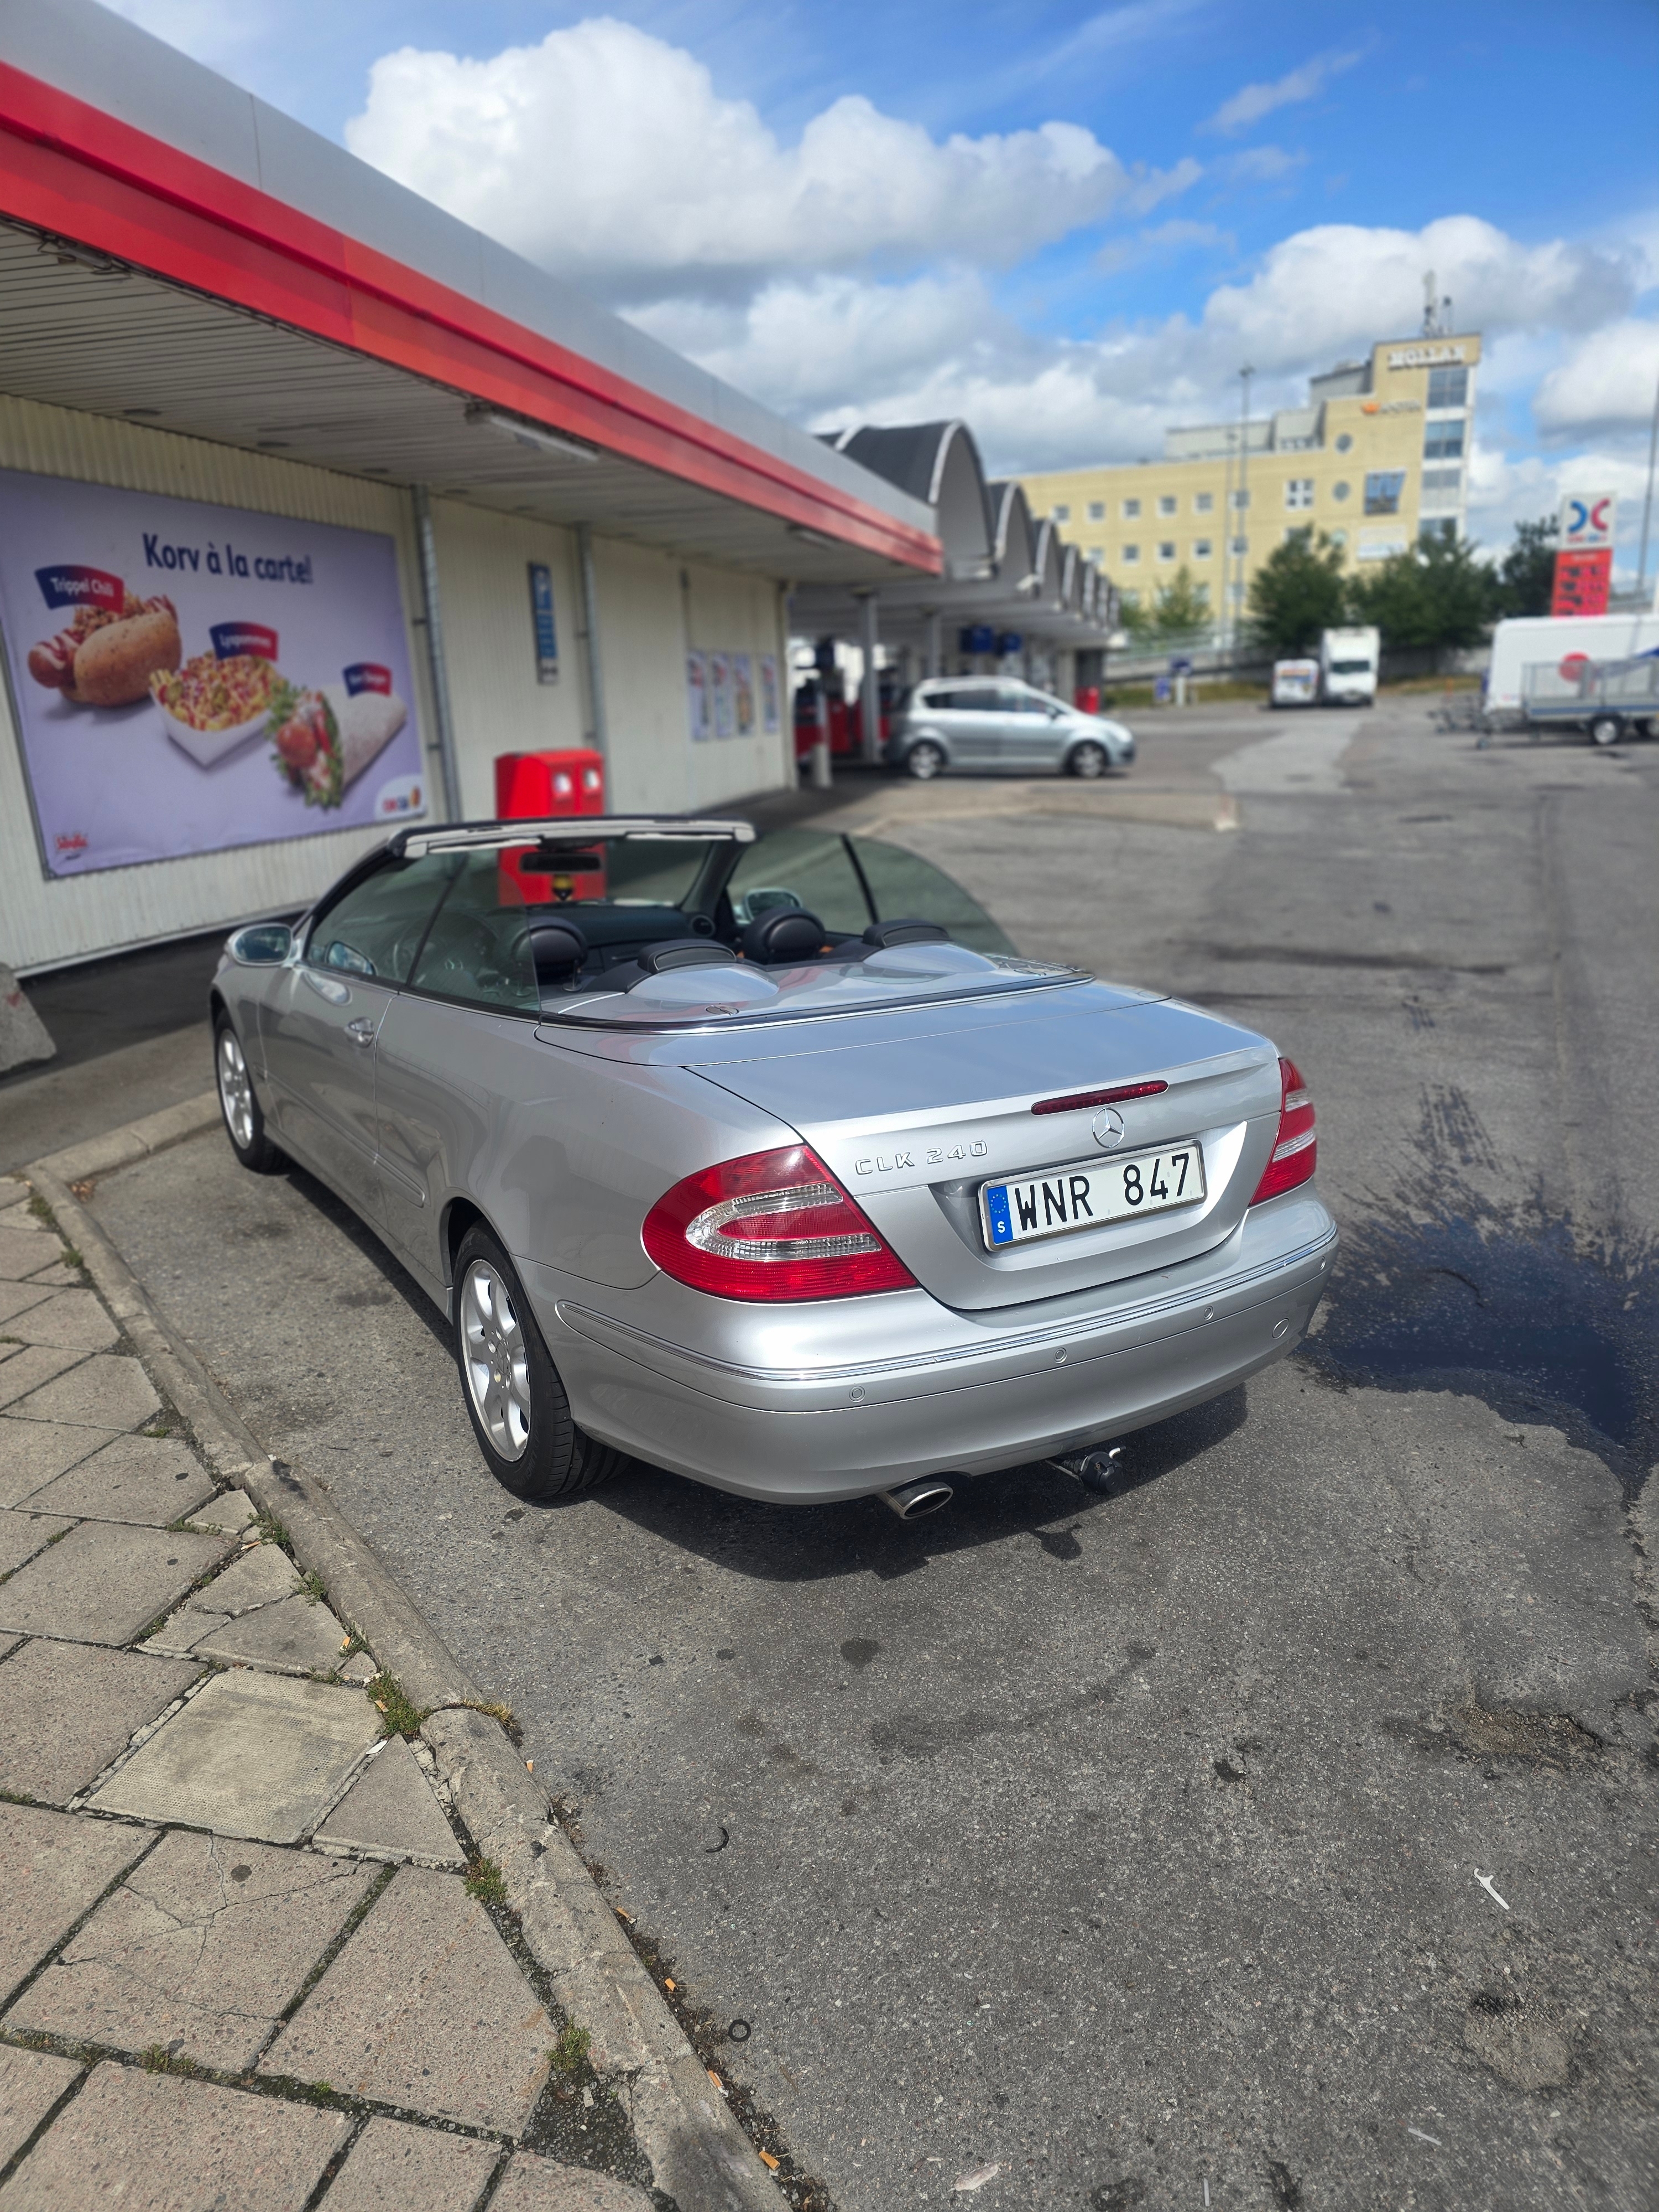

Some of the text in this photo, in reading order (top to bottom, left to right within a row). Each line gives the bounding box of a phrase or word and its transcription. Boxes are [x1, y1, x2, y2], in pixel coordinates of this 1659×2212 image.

[143, 533, 200, 572] Korv
[207, 541, 222, 575] à
[226, 544, 251, 577] la
[50, 577, 90, 596] Trippel
[855, 1140, 988, 1175] CLK 240
[1014, 1152, 1190, 1232] WNR 847
[997, 1220, 1005, 1233] S
